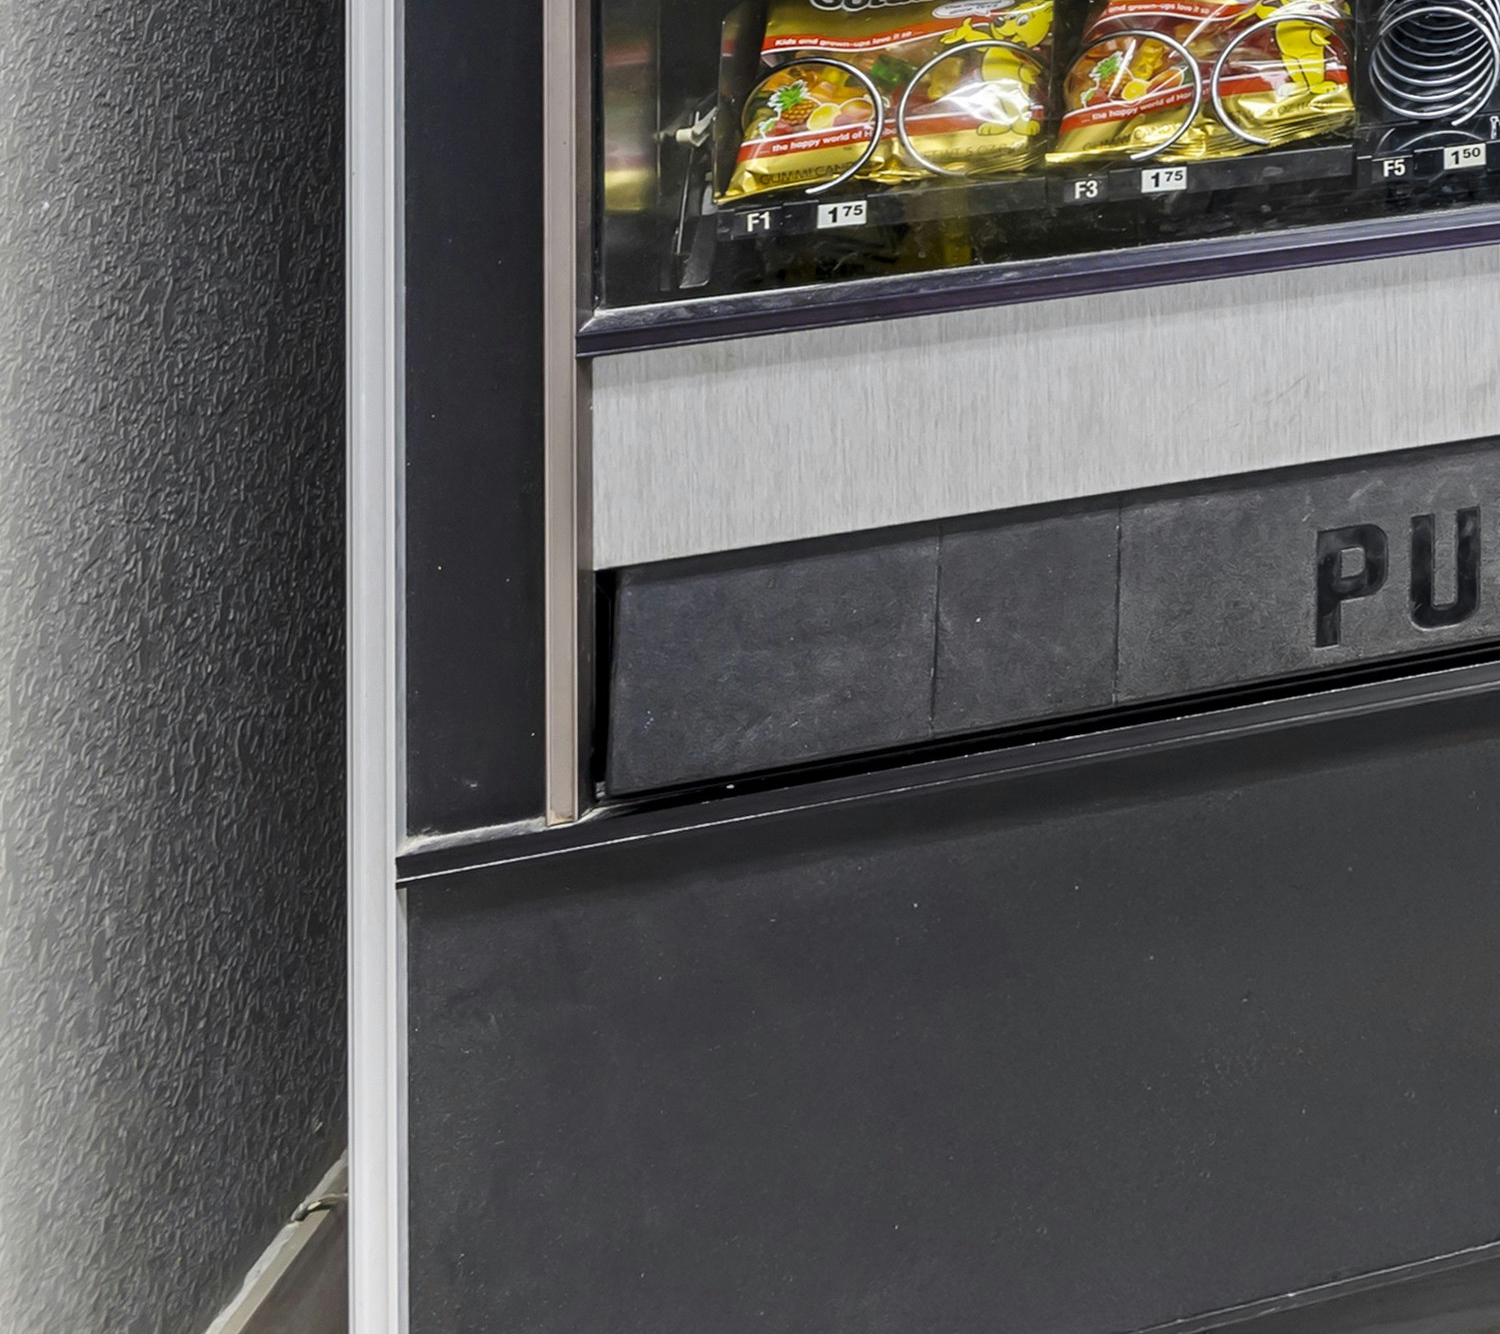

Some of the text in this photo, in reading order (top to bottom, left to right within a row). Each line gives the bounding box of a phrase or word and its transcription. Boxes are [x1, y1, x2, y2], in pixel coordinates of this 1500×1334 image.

[772, 130, 862, 153] the happy world of
[1383, 160, 1406, 177] F5
[747, 212, 771, 231] F1
